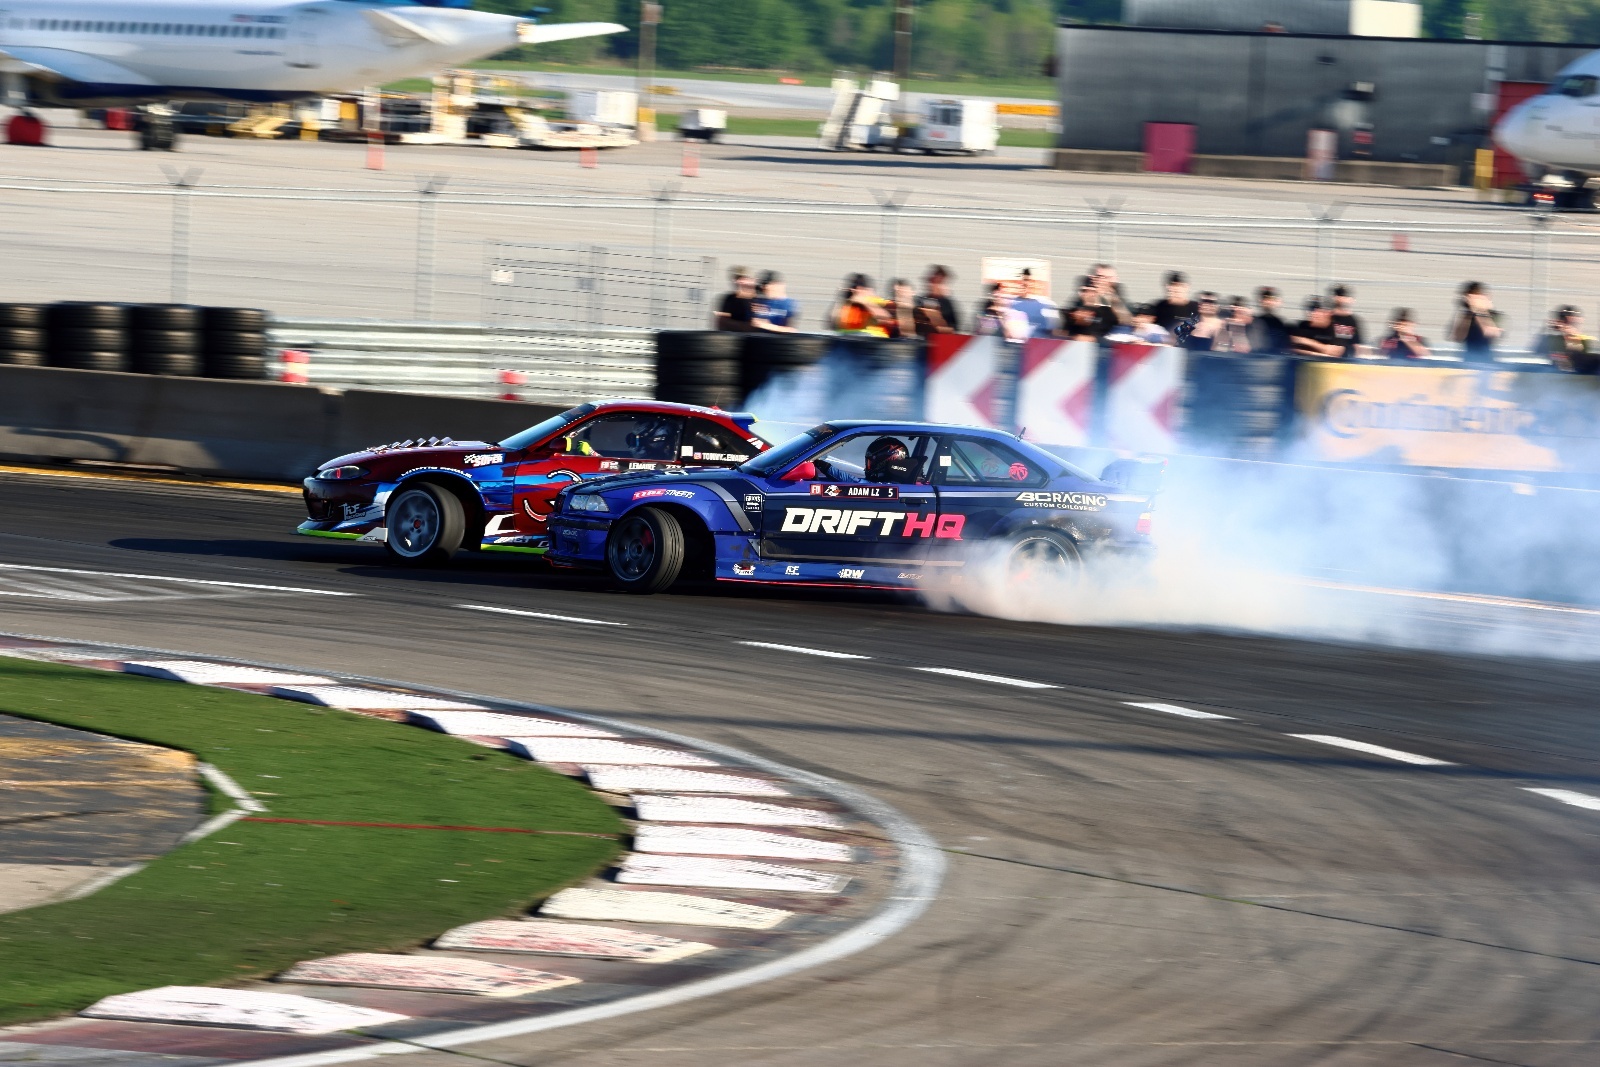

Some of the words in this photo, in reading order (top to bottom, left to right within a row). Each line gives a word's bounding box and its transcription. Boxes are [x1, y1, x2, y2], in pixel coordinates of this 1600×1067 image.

[848, 487, 869, 496] ADAM
[870, 488, 880, 497] LZ
[887, 488, 894, 497] 5
[1016, 492, 1052, 502] BC
[1052, 492, 1107, 507] RACING
[780, 507, 967, 541] DRIFTHQ
